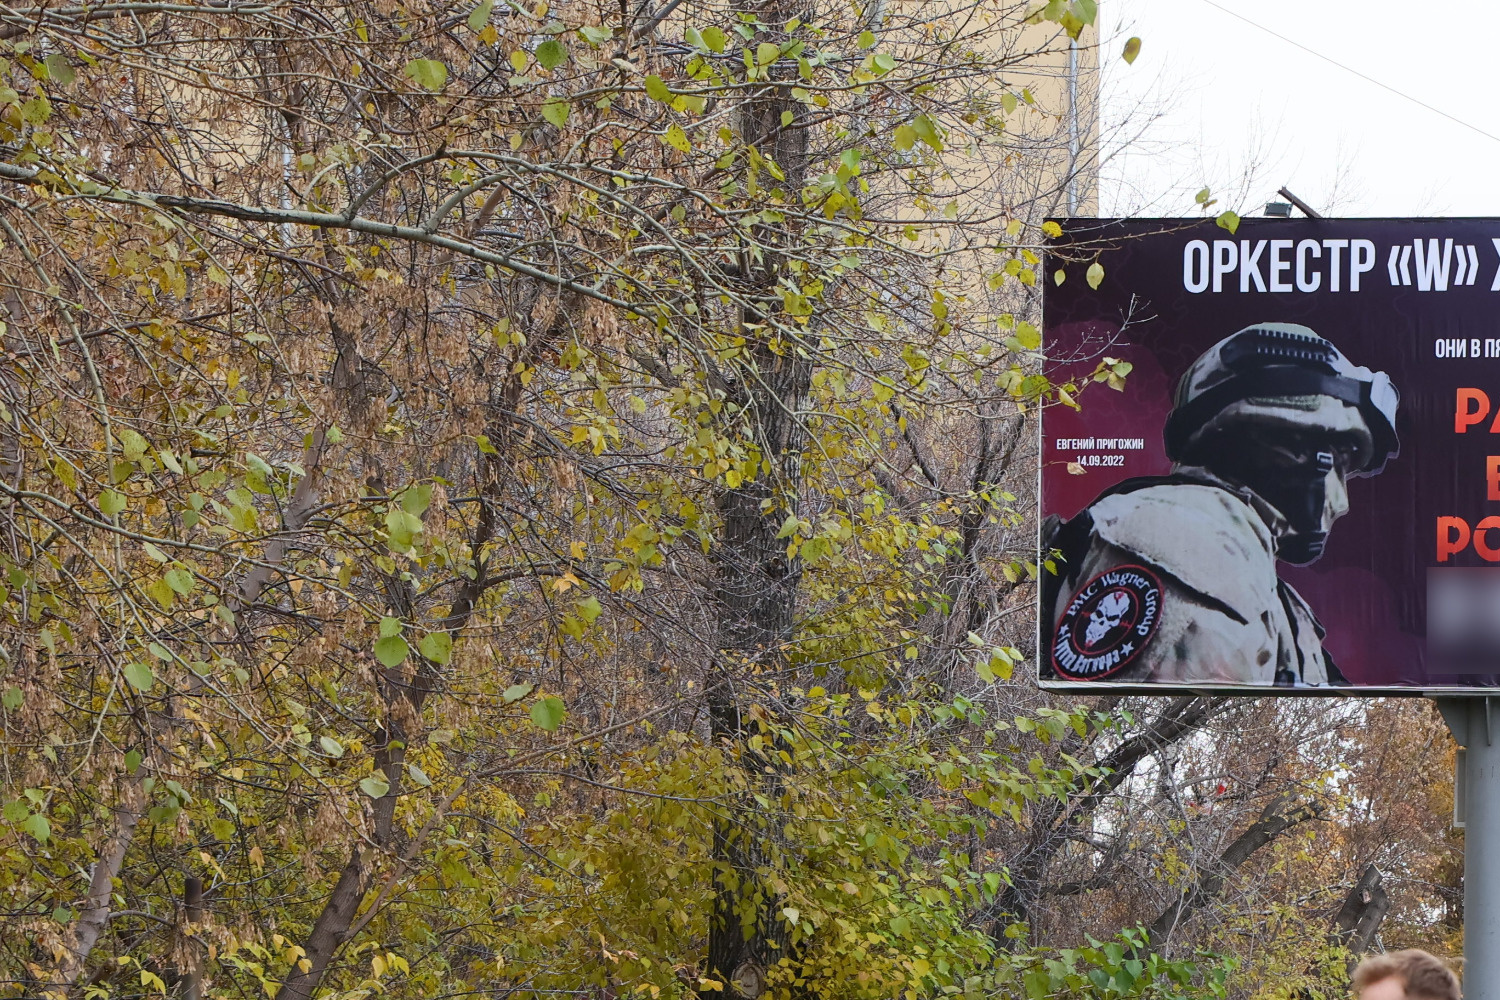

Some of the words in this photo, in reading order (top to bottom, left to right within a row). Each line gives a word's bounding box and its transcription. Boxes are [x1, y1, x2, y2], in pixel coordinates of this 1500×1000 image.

[1183, 238, 1376, 294] ОРКЕСТР
[1387, 238, 1479, 292] «W»
[1435, 338, 1467, 358] ОНИ
[1470, 338, 1481, 358] В
[1056, 436, 1095, 450] ЕВГЕНИЙ
[1096, 438, 1144, 450] ПРИГОЖИН
[1075, 455, 1125, 467] 14.09.2022
[1136, 588, 1160, 636] Group
